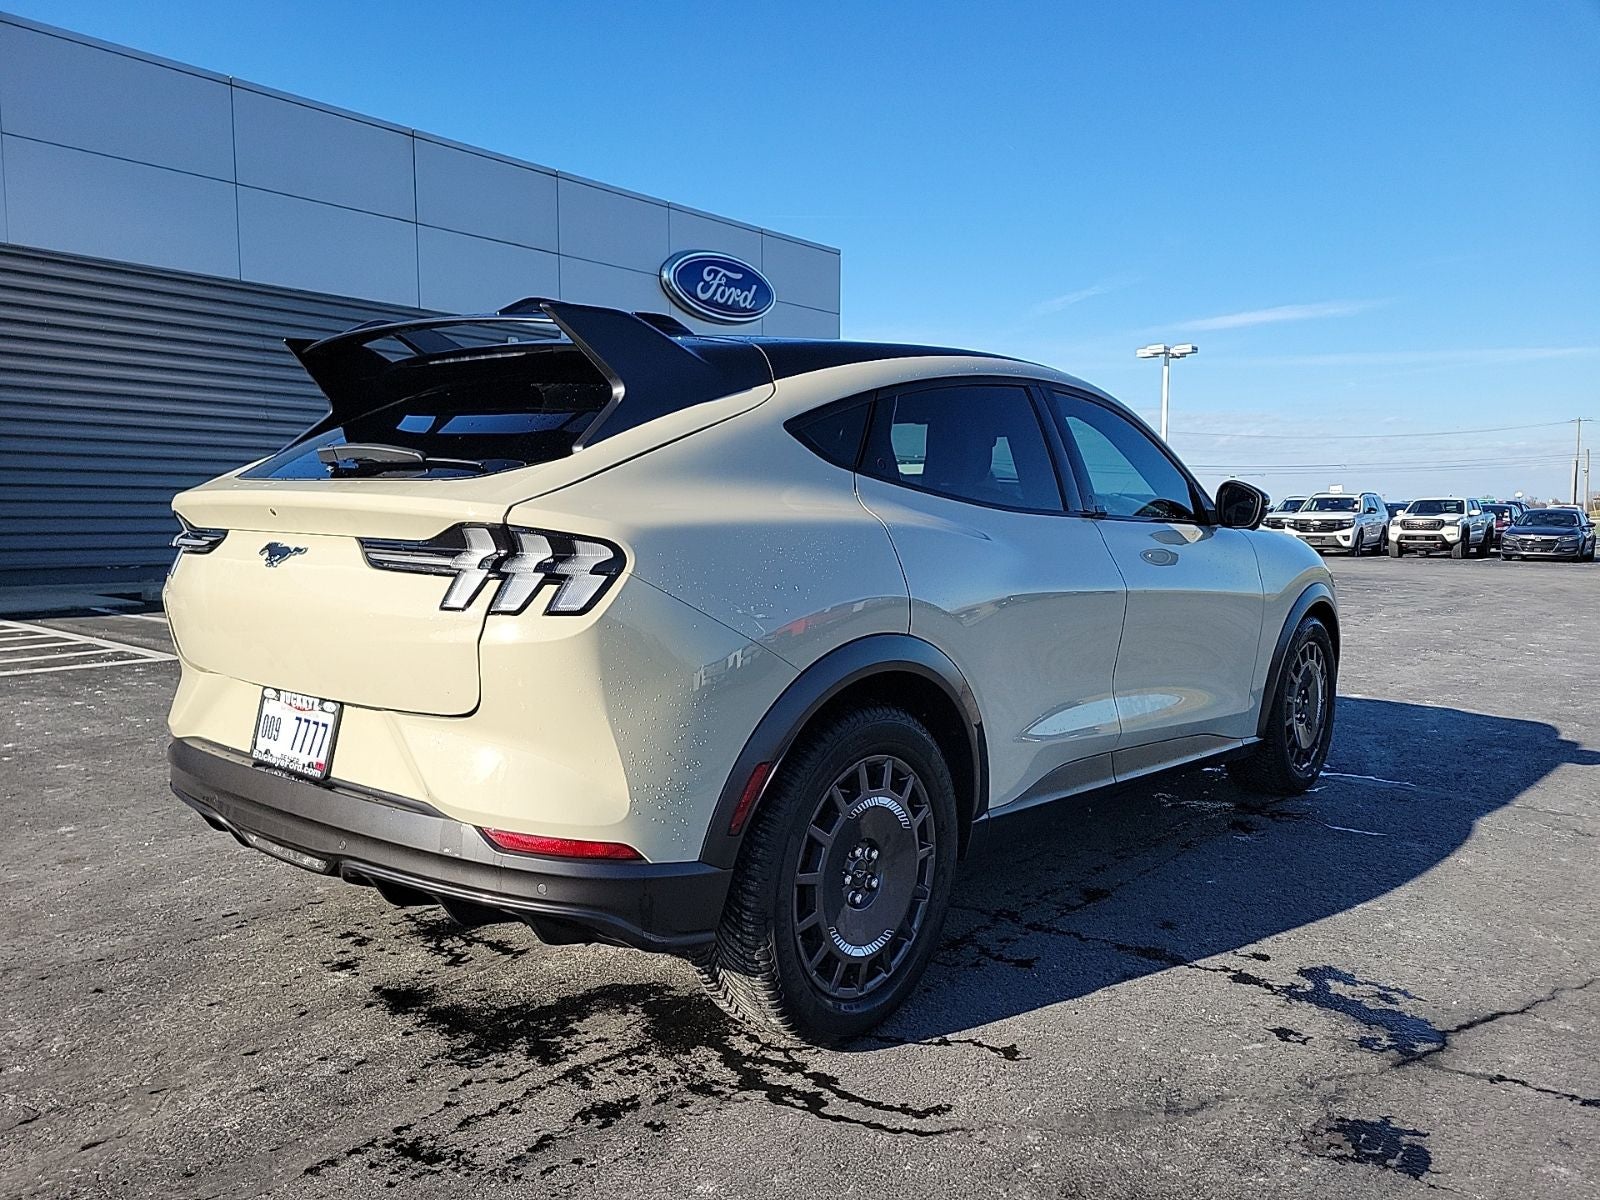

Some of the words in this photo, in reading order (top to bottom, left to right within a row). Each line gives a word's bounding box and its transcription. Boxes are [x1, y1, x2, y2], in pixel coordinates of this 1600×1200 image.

[696, 265, 758, 309] Ford
[261, 714, 281, 741] 009
[290, 716, 328, 758] 7777
[252, 750, 321, 778] BuckeyeFord.com
